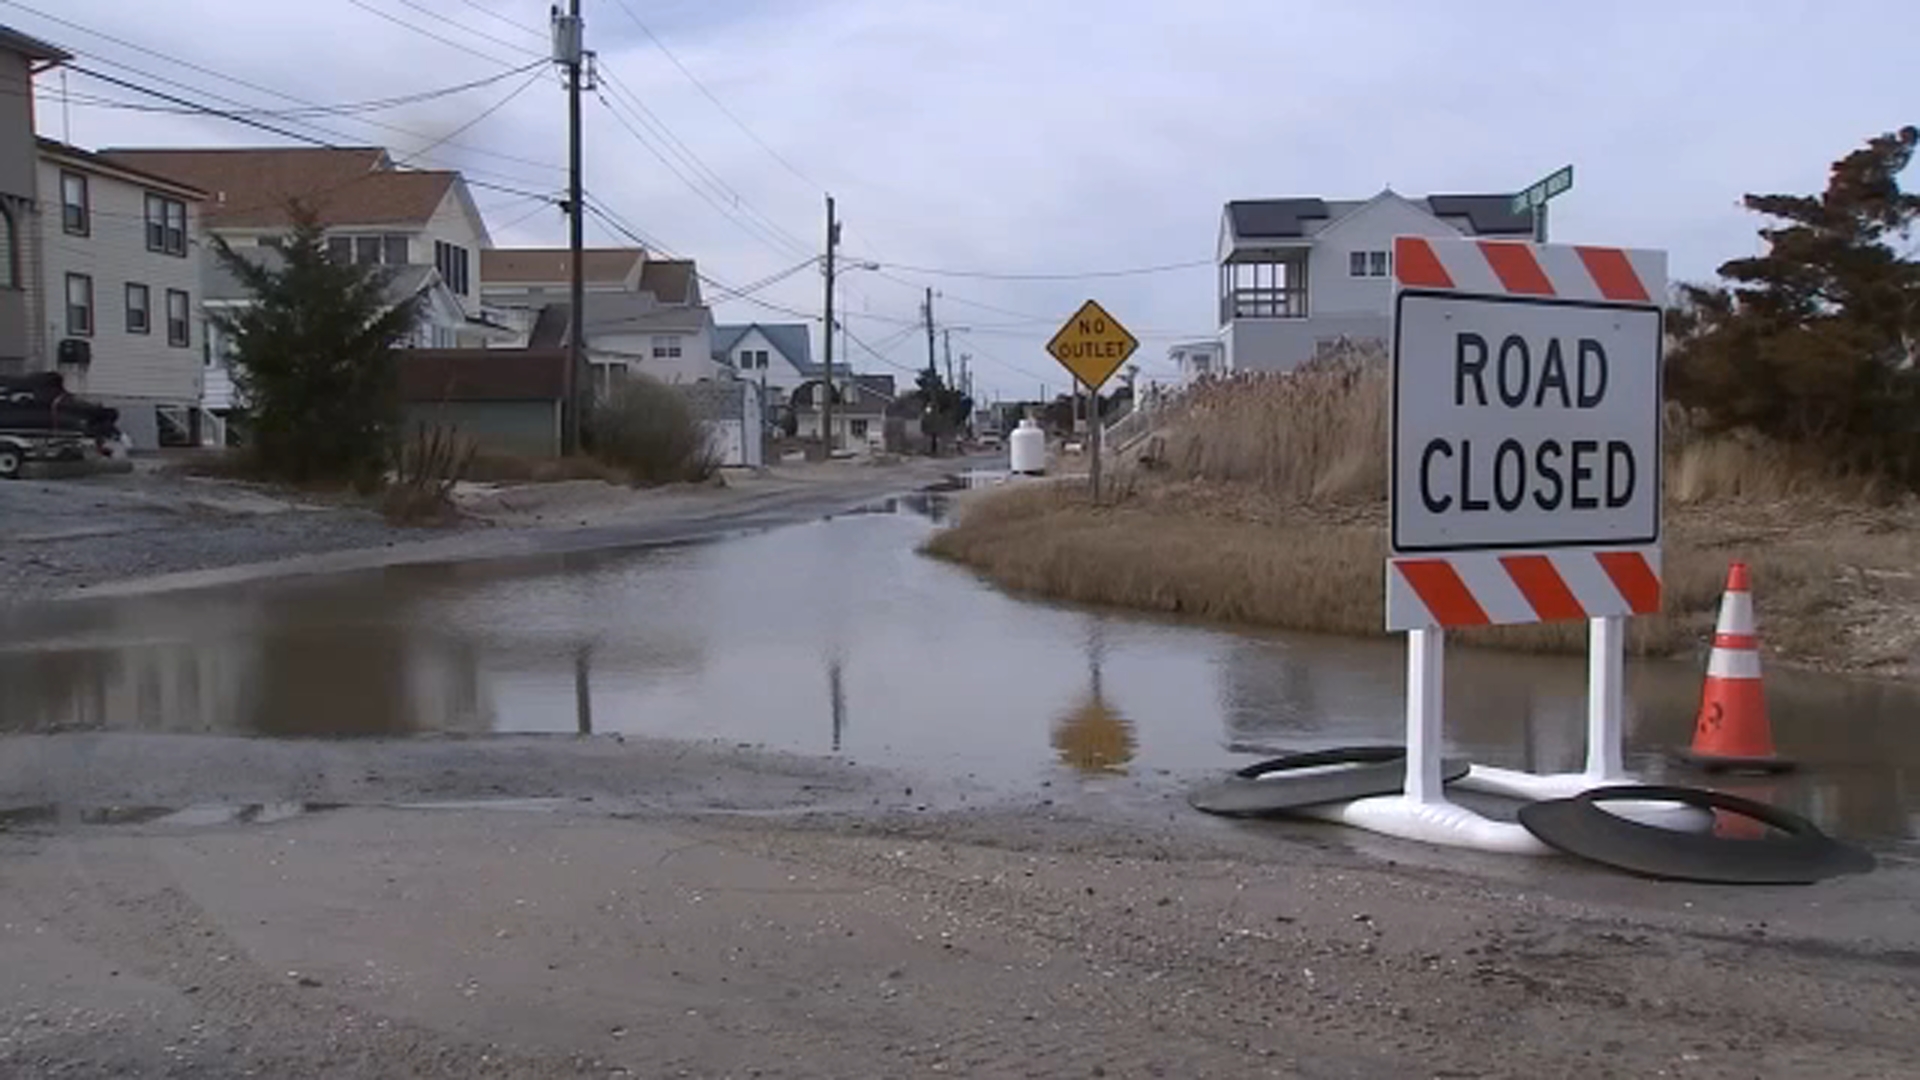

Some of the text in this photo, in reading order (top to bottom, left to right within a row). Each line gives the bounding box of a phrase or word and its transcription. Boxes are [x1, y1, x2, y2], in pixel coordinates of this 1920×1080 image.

[1079, 318, 1105, 334] NO
[1059, 341, 1125, 358] OUTLET
[1455, 332, 1608, 408] ROAD
[1420, 438, 1636, 513] CLOSED
